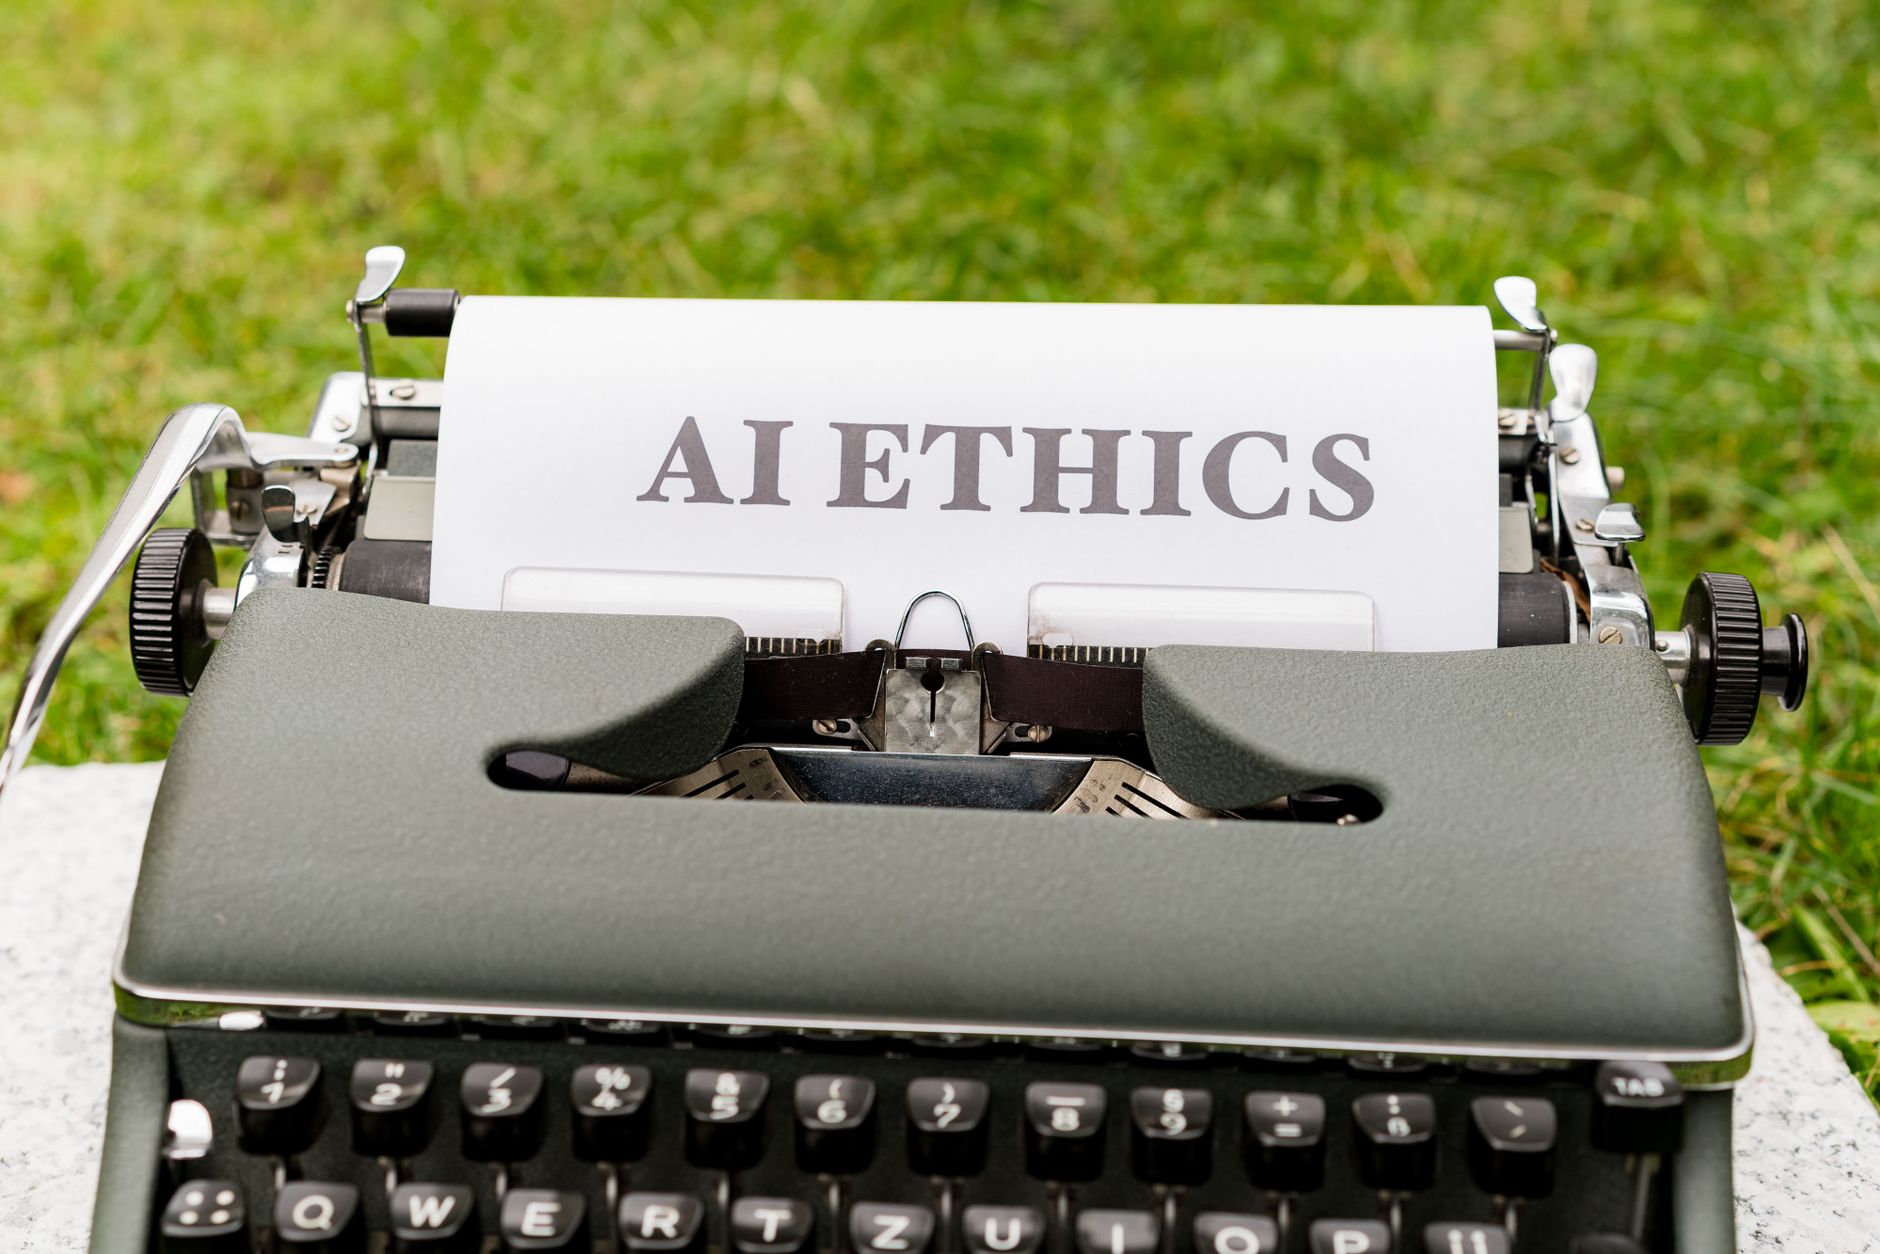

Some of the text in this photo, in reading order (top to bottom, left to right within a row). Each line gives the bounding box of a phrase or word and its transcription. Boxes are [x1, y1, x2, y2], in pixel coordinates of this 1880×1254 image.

[637, 416, 1375, 522] AI ETHICS
[261, 1081, 284, 1104] 1
[370, 1083, 403, 1106] 2
[1611, 1076, 1665, 1097] TAB
[482, 1087, 512, 1114] 3
[710, 1094, 740, 1121] 5
[817, 1099, 847, 1123] 6
[934, 1103, 961, 1128] 7
[1051, 1107, 1080, 1131] 8
[1160, 1112, 1187, 1136] 9
[291, 1194, 335, 1231] Q
[408, 1195, 456, 1228] W
[520, 1201, 562, 1237] E
[640, 1204, 681, 1238] R
[753, 1207, 791, 1242] T
[871, 1213, 911, 1249] Z
[983, 1216, 1022, 1250] U
